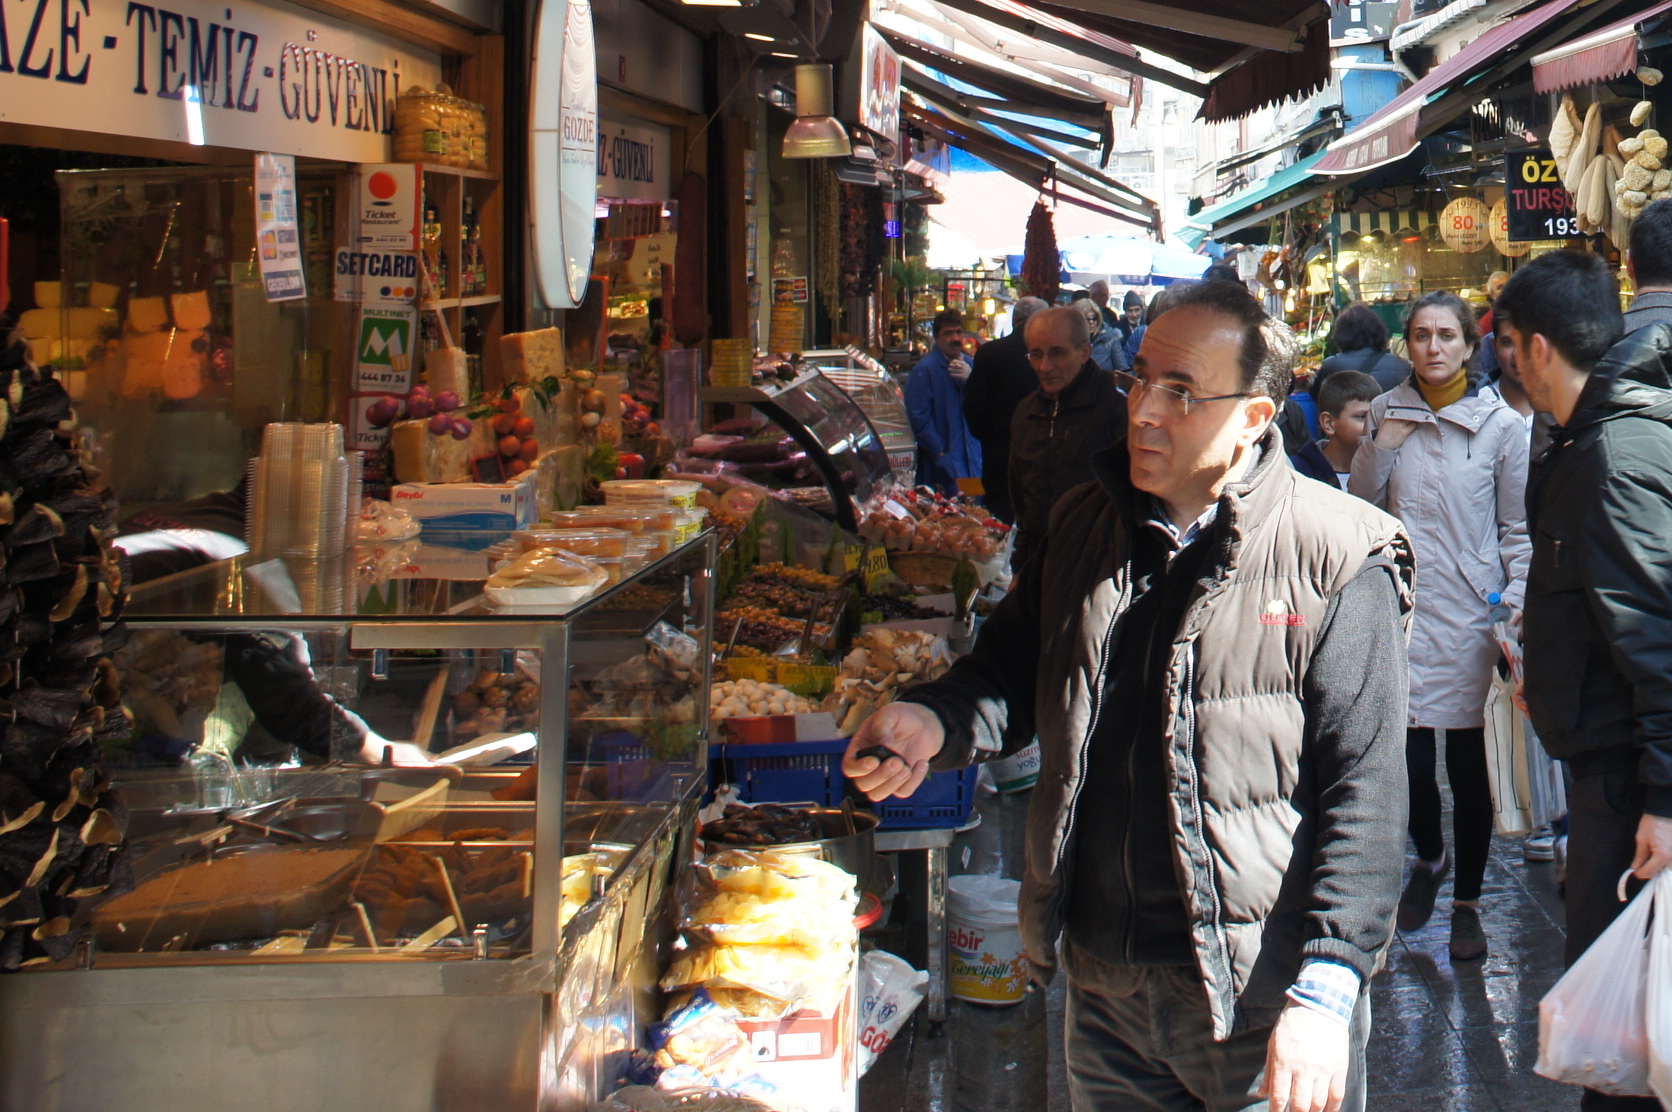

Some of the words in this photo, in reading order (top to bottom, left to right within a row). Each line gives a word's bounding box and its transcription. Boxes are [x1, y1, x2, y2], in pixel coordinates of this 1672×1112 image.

[613, 129, 654, 183] GÜVENLİ
[1522, 156, 1558, 183] ÖZ
[365, 210, 396, 219] Ticket
[1453, 215, 1473, 230] 80
[1501, 215, 1509, 232] 8
[337, 251, 418, 278] SETCARD
[361, 373, 378, 381] 444
[380, 374, 392, 382] 87
[394, 375, 405, 383] 36
[396, 490, 424, 500] Beybi
[500, 494, 512, 503] M
